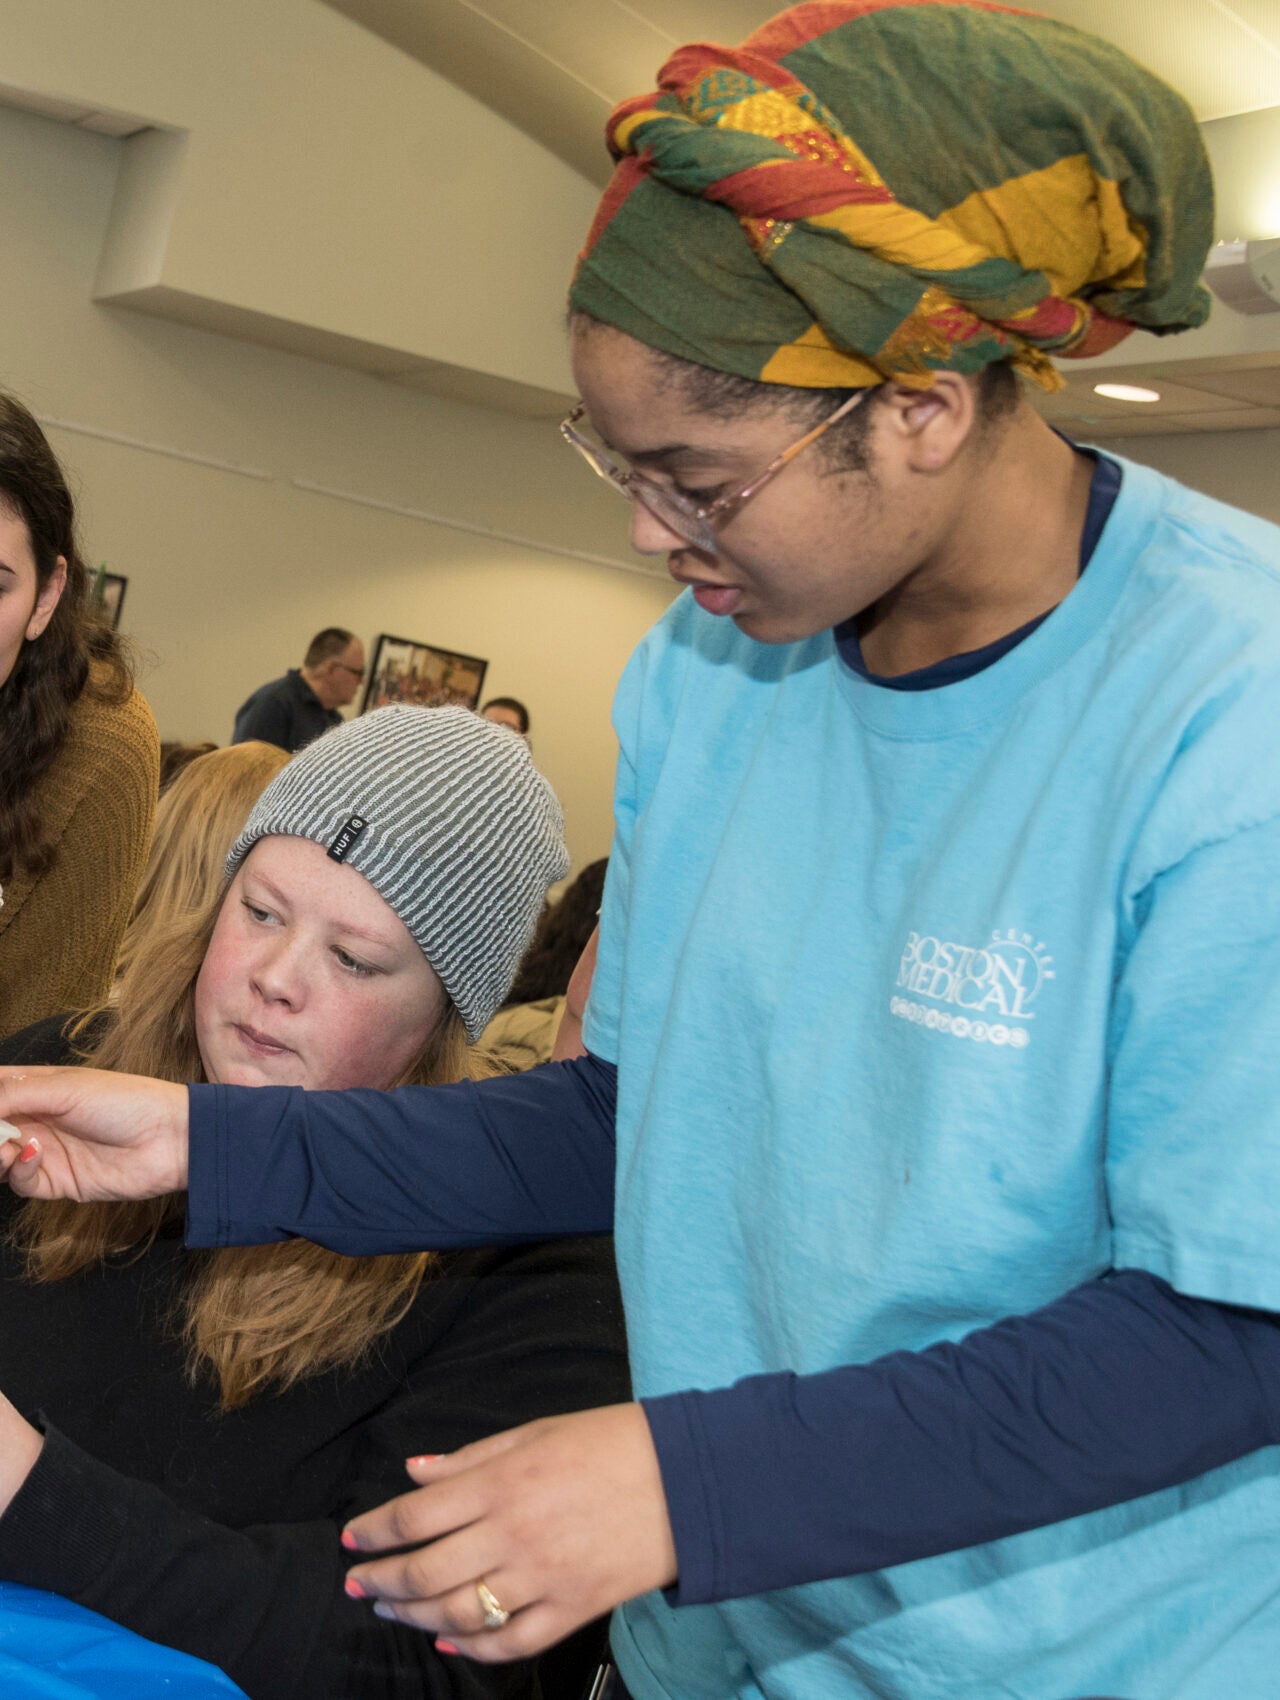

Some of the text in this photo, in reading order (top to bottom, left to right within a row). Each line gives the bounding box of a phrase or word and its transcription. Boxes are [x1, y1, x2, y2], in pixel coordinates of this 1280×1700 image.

[333, 832, 351, 856] HUF
[895, 955, 1036, 1019] MEDICAL
[901, 930, 1027, 989] BOSTON
